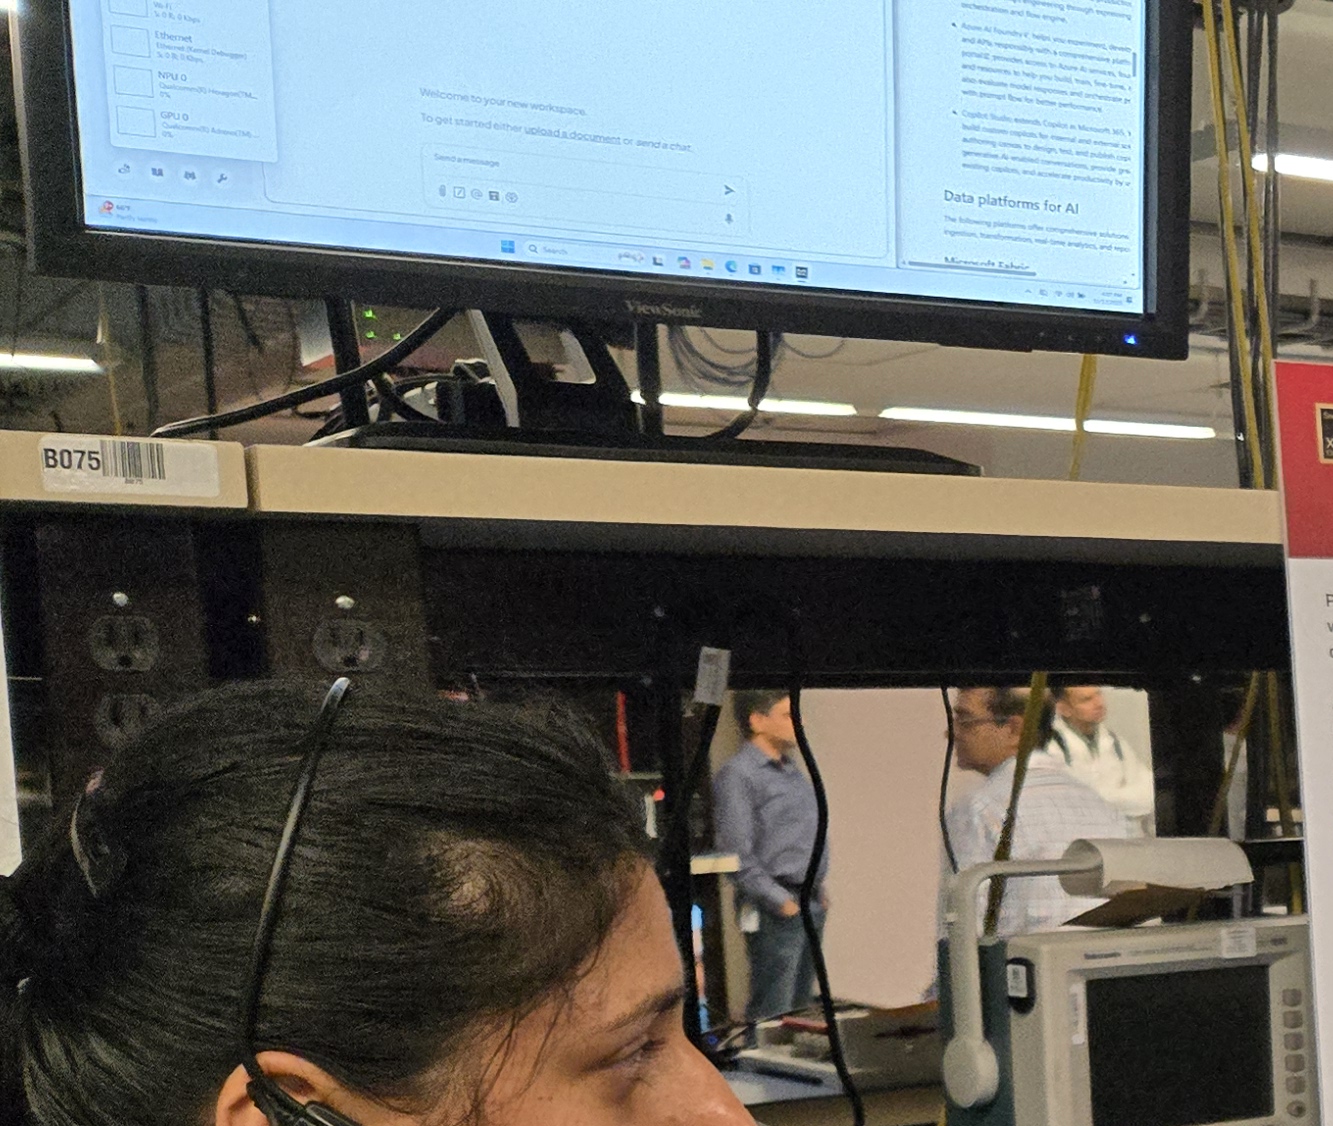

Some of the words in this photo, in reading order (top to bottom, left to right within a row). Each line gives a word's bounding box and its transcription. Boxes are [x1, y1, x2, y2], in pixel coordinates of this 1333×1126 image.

[155, 30, 192, 43] Ethernet
[158, 71, 178, 81] NPU
[420, 88, 468, 101] Welcome
[483, 97, 505, 106] your
[160, 111, 180, 120] GPU
[944, 189, 974, 203] Data
[978, 194, 1039, 210] platforms
[1044, 199, 1061, 212] for
[1065, 203, 1078, 214] AI
[44, 448, 100, 470] B075
